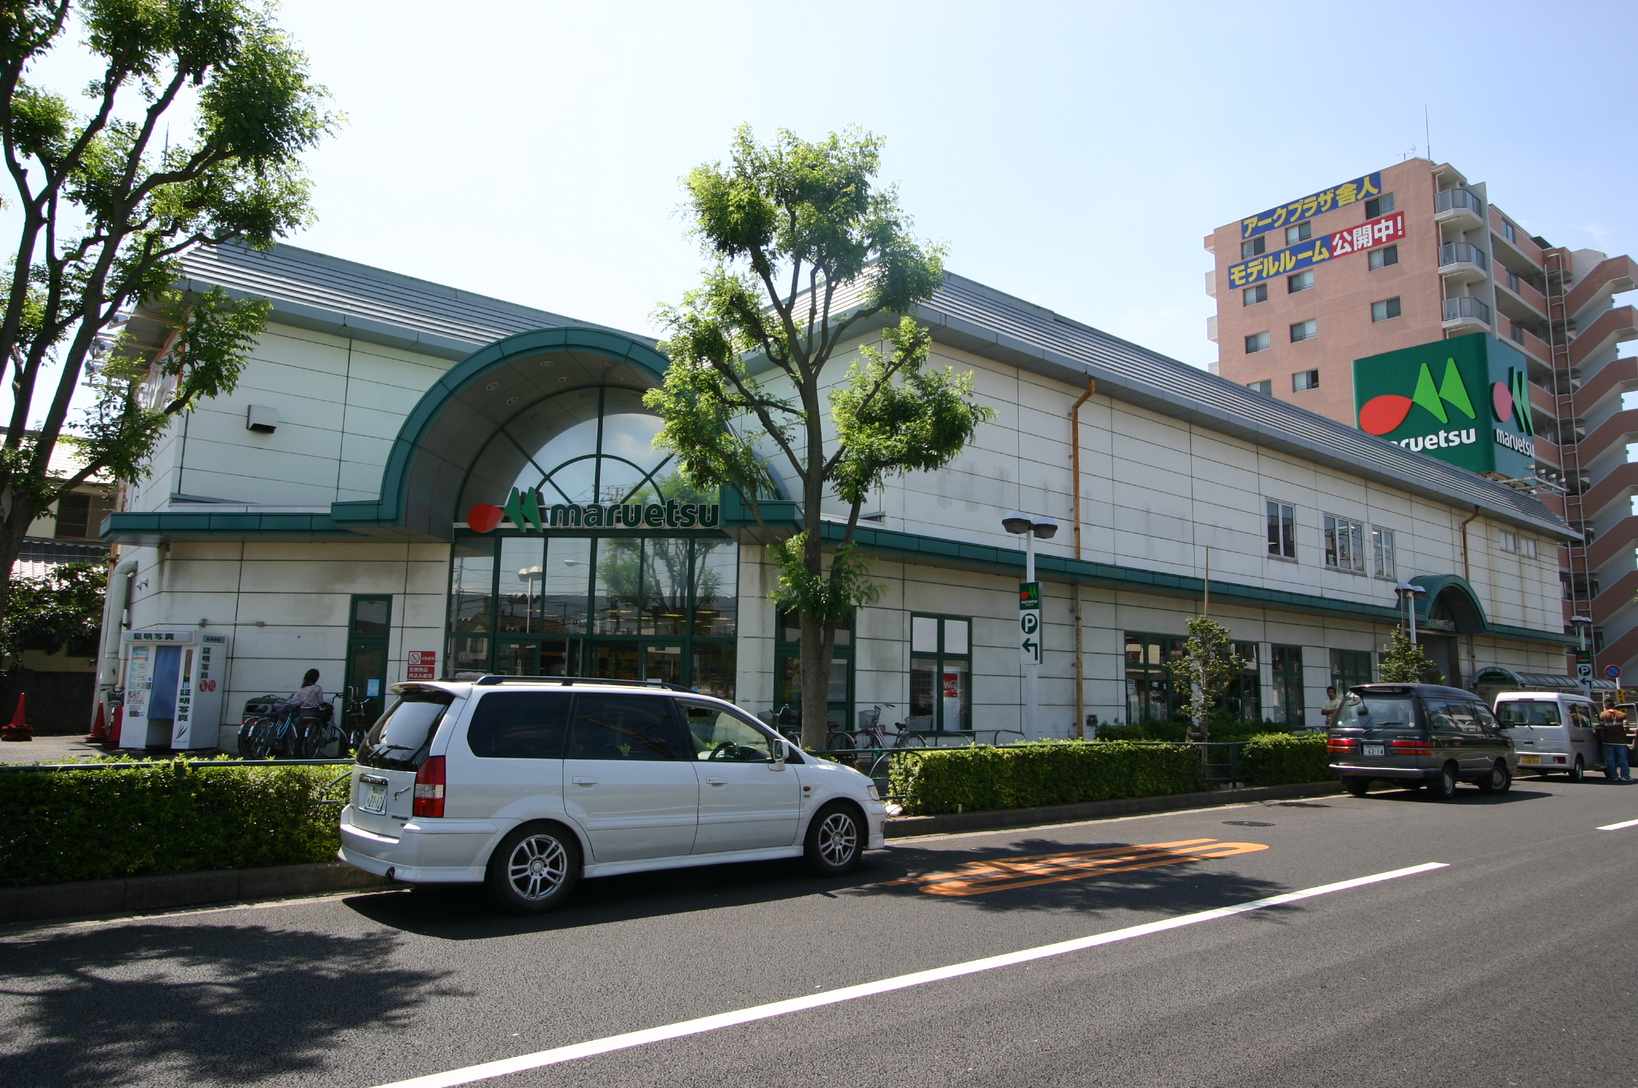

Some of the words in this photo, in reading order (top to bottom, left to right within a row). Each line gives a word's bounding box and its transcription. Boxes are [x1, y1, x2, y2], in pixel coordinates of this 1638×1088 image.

[1243, 176, 1379, 237] アークプラザ舎人
[1495, 427, 1536, 458] maruetsu
[550, 501, 721, 529] maruetsu
